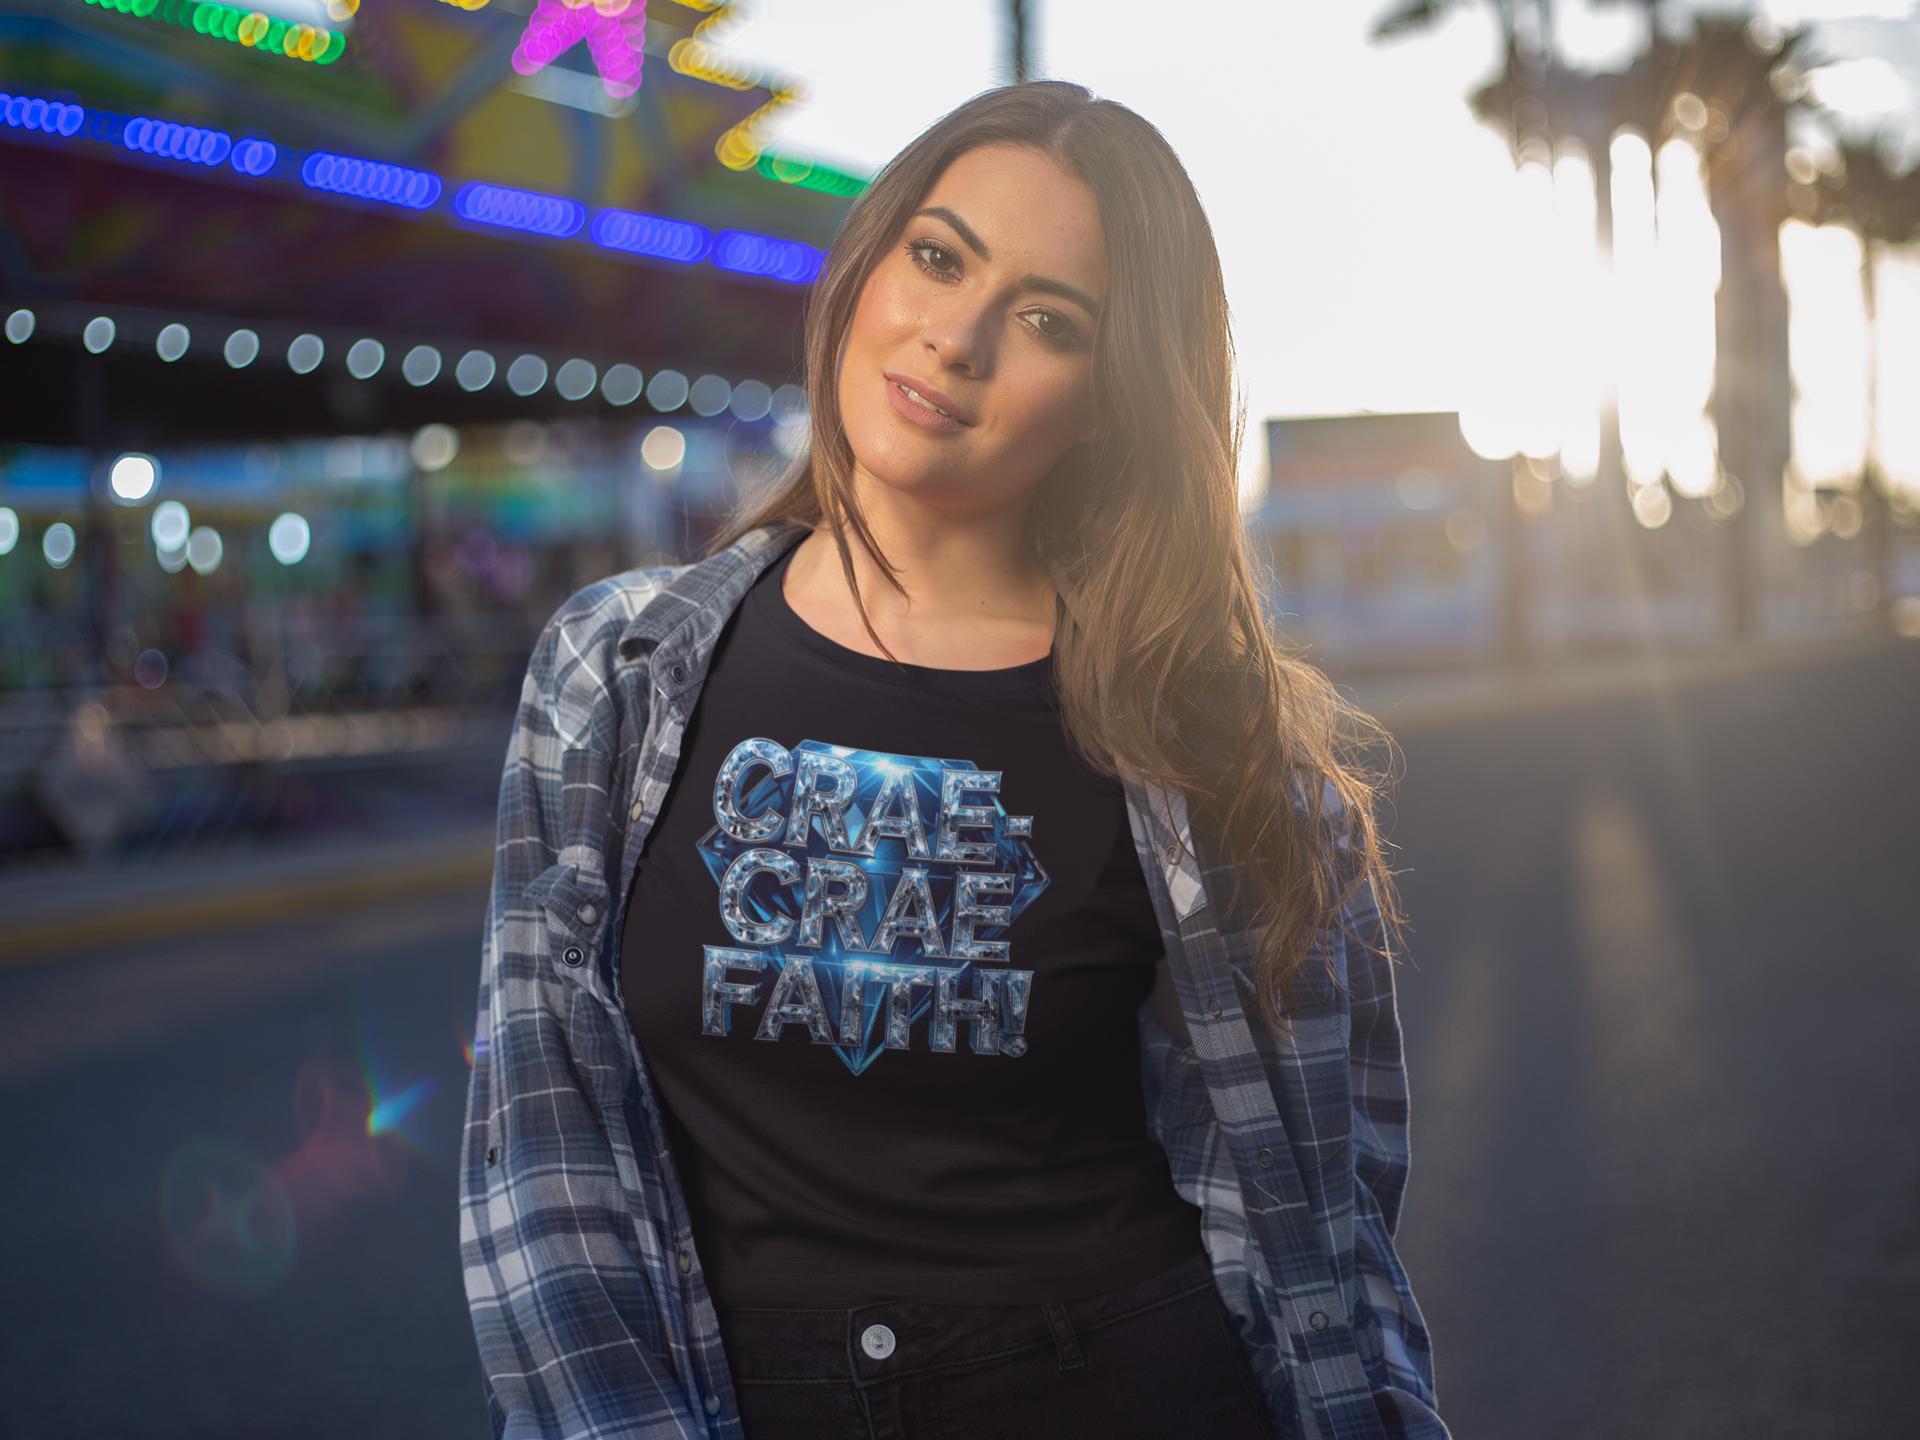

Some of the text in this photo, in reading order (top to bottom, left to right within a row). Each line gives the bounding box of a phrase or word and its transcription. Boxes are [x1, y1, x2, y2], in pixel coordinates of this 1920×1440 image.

[713, 738, 1034, 864] CRAE-
[719, 848, 1015, 962] CRAE
[701, 944, 1035, 1057] FAITH!
